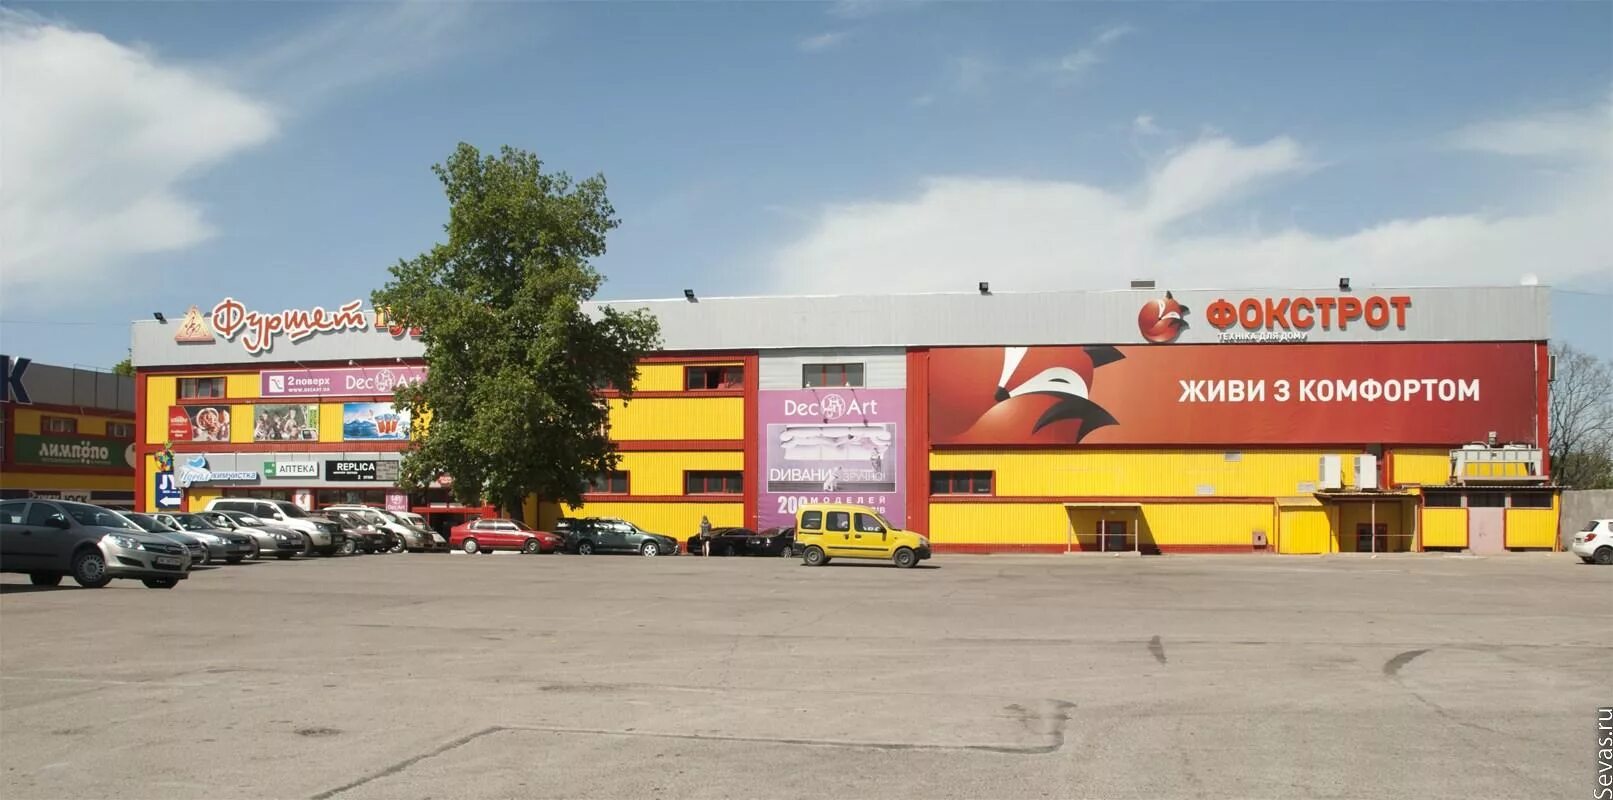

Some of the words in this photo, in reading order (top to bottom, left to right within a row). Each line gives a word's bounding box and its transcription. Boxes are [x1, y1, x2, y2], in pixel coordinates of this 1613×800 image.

[1206, 296, 1411, 331] ФОКСТРОТ
[212, 298, 367, 352] Фуршет
[1218, 332, 1257, 340] ТЕХНІКА
[1259, 331, 1279, 340] ДЛЯ
[1281, 331, 1308, 340] ДОМУ
[346, 375, 374, 390] Dec
[1179, 379, 1265, 402] ЖИВИ
[1300, 378, 1480, 402] КОМФОРТОМ
[784, 400, 819, 416] Dec
[846, 399, 878, 415] Art
[279, 465, 315, 473] АПТЕКА
[336, 462, 375, 471] REPLICA
[810, 495, 886, 504] МОДЕЛЕЙ
